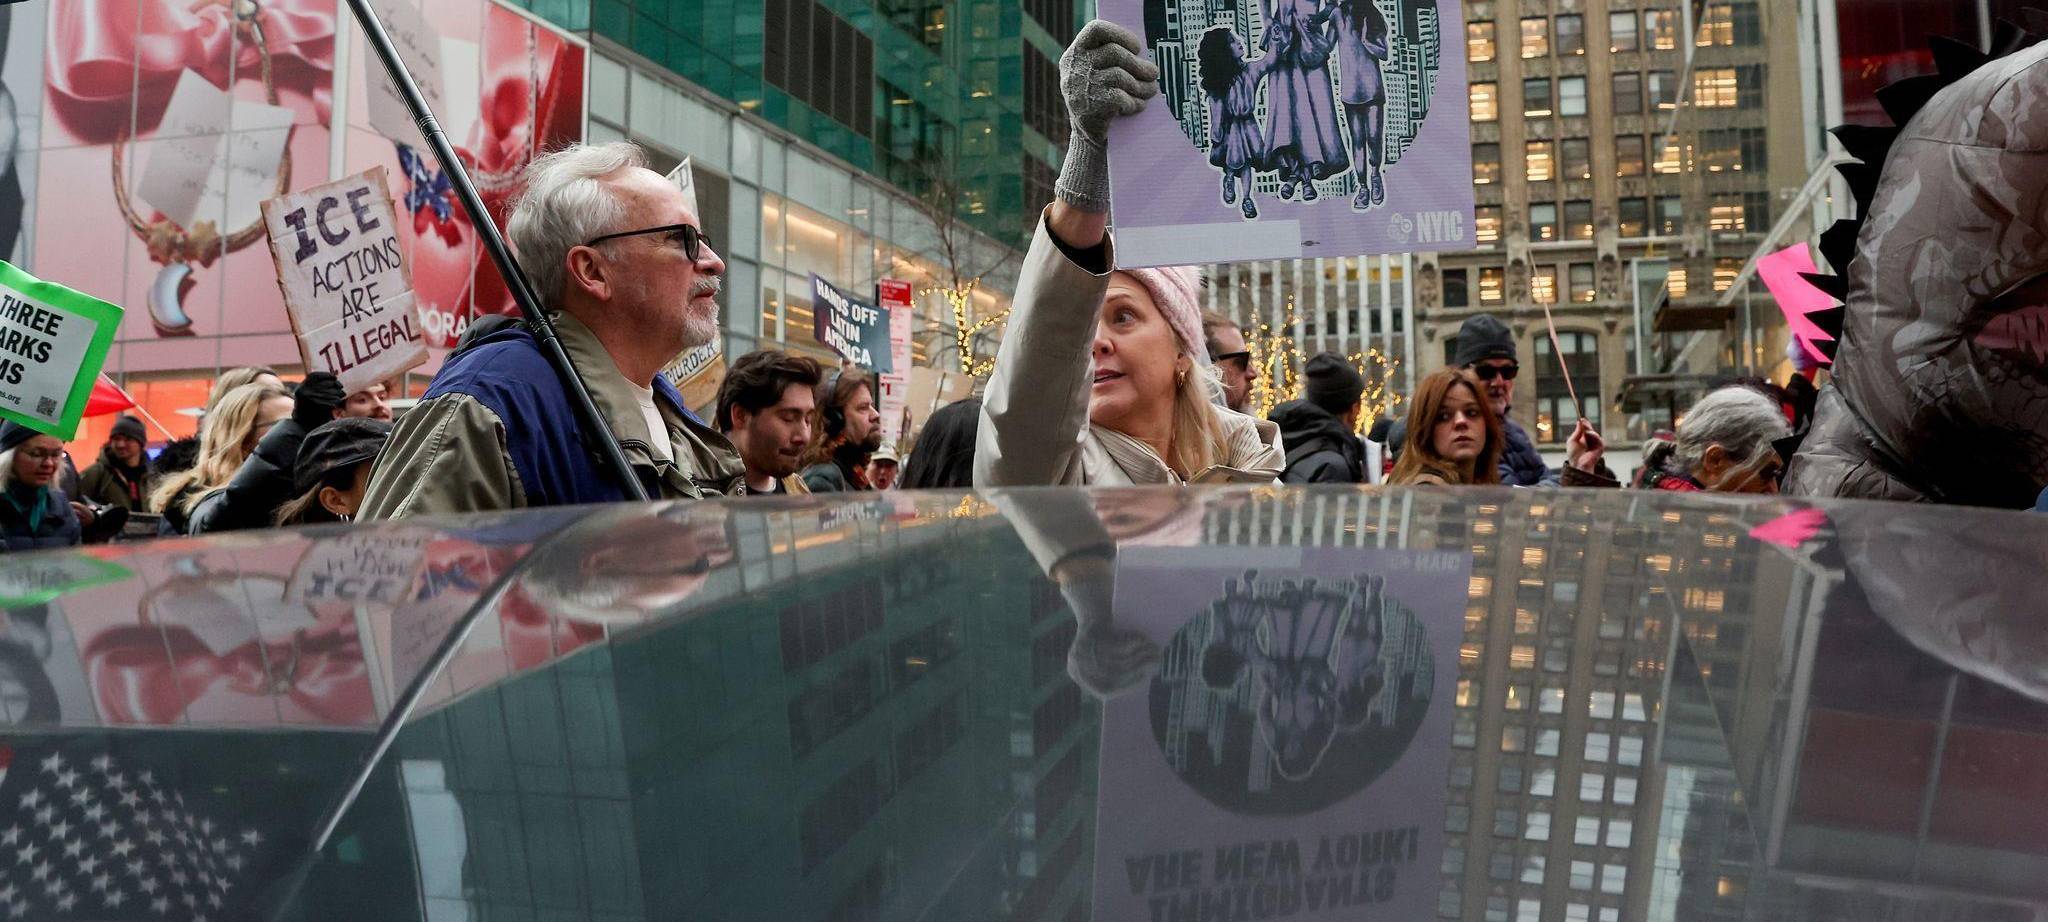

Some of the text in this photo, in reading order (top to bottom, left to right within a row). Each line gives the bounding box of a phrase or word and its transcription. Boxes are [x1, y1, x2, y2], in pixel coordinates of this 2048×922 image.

[284, 186, 380, 264] ICE
[1416, 211, 1464, 243] NYIC
[313, 236, 401, 298] ACTIONS
[0, 294, 64, 337] THREE
[342, 282, 384, 328] ARE
[816, 279, 849, 317] HANDS
[851, 304, 879, 326] OFF
[830, 308, 860, 342] LATIN
[319, 314, 421, 376] ILLEGAL
[824, 326, 872, 366] AMERICA
